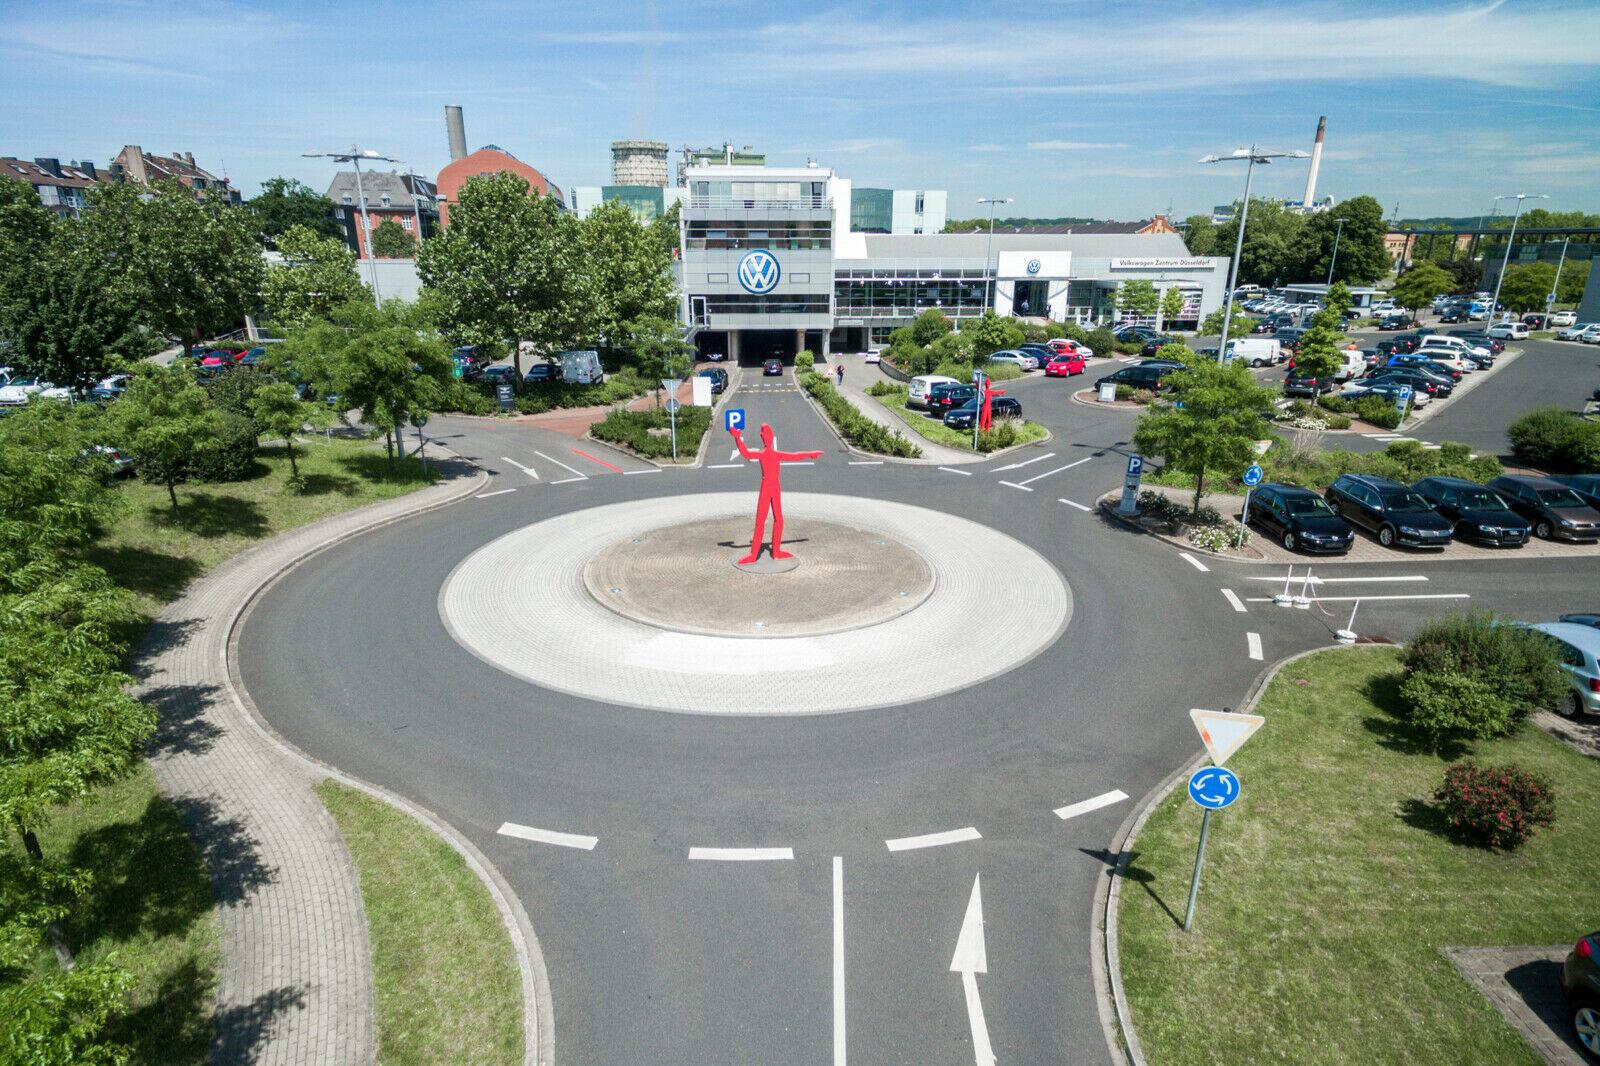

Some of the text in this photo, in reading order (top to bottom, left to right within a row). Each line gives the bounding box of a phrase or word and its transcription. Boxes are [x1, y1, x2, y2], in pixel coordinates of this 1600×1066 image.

[1119, 259, 1154, 267] Volkswagen
[1180, 258, 1210, 266] Düsseldorf
[1400, 386, 1409, 397] P
[729, 412, 741, 428] P
[1130, 458, 1141, 472] P
